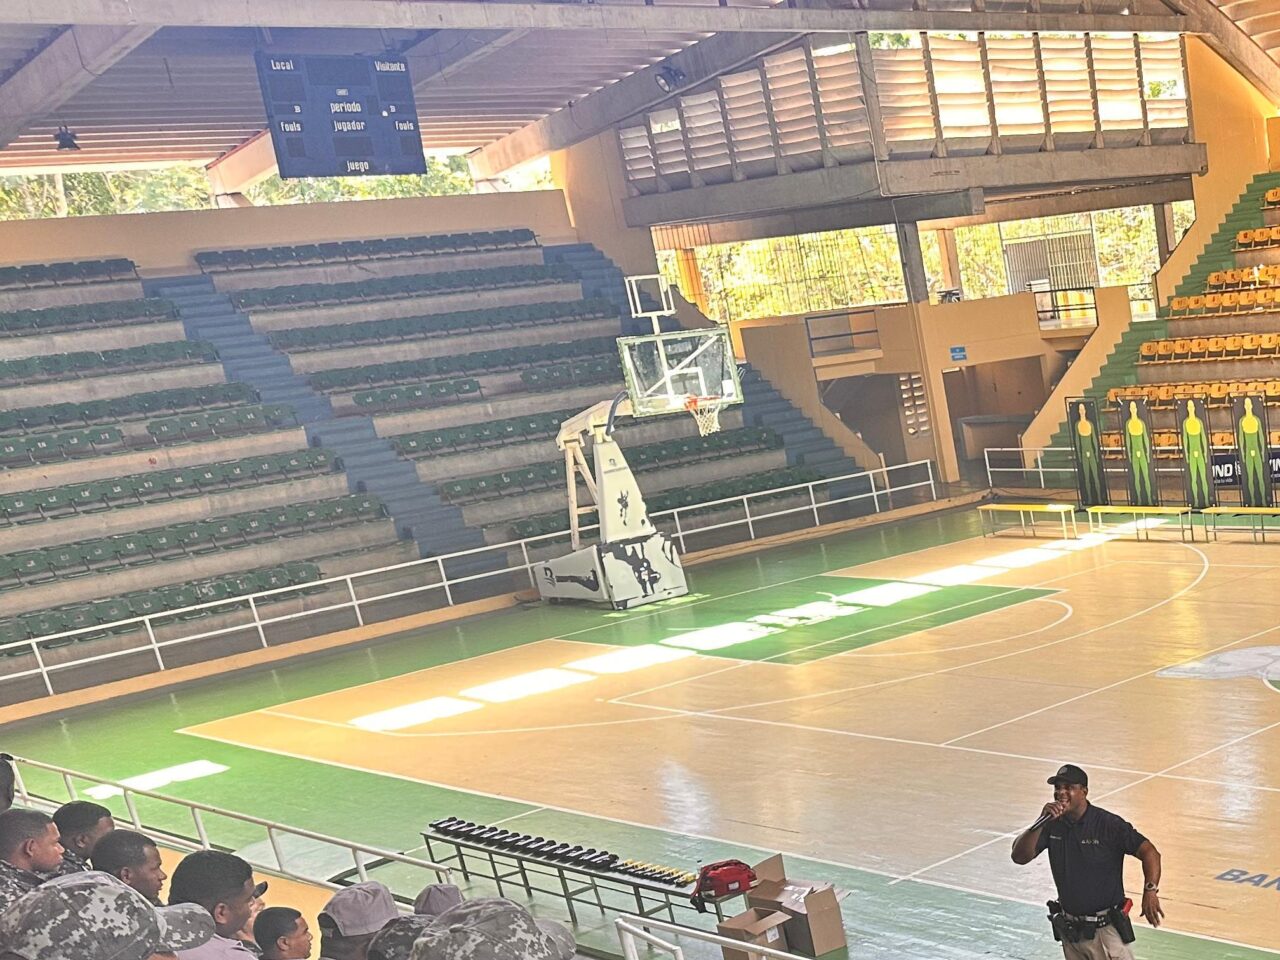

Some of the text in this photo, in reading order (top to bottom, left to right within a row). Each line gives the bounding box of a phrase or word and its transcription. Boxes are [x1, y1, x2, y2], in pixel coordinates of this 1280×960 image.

[271, 60, 294, 70] Local
[375, 61, 405, 72] Visitante
[330, 102, 361, 114] periodo
[281, 122, 301, 131] fouls
[334, 120, 365, 131] jugador
[395, 121, 414, 130] fouls
[347, 160, 369, 172] juego
[1212, 464, 1233, 477] IND
